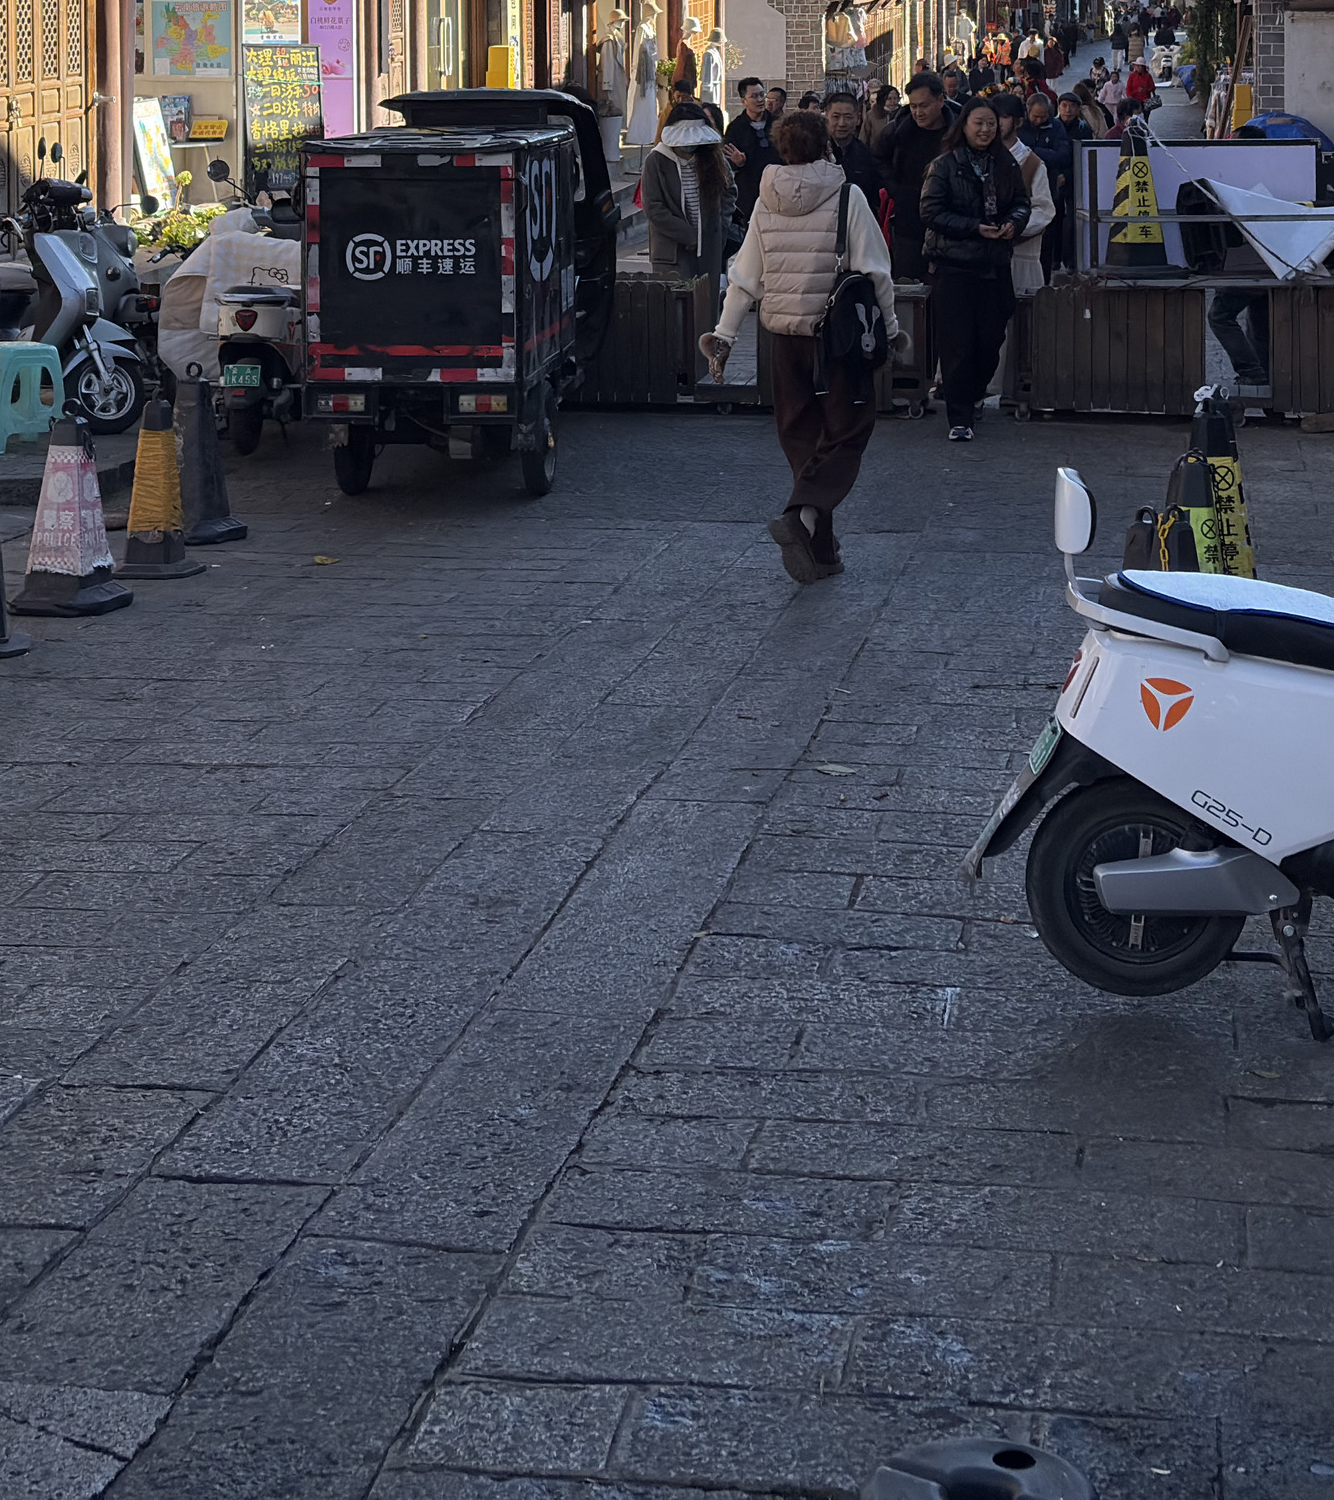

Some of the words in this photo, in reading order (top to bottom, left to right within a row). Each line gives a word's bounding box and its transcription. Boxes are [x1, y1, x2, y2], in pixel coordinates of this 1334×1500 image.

[247, 47, 273, 67] 大理
[290, 49, 318, 67] 丽江
[262, 101, 301, 118] 二日游
[251, 118, 307, 140] 香格里拉
[396, 239, 476, 256] EXPRESS
[396, 257, 476, 274] 顺丰速运
[36, 532, 78, 547] POLICE
[1191, 789, 1273, 846] G25-D
